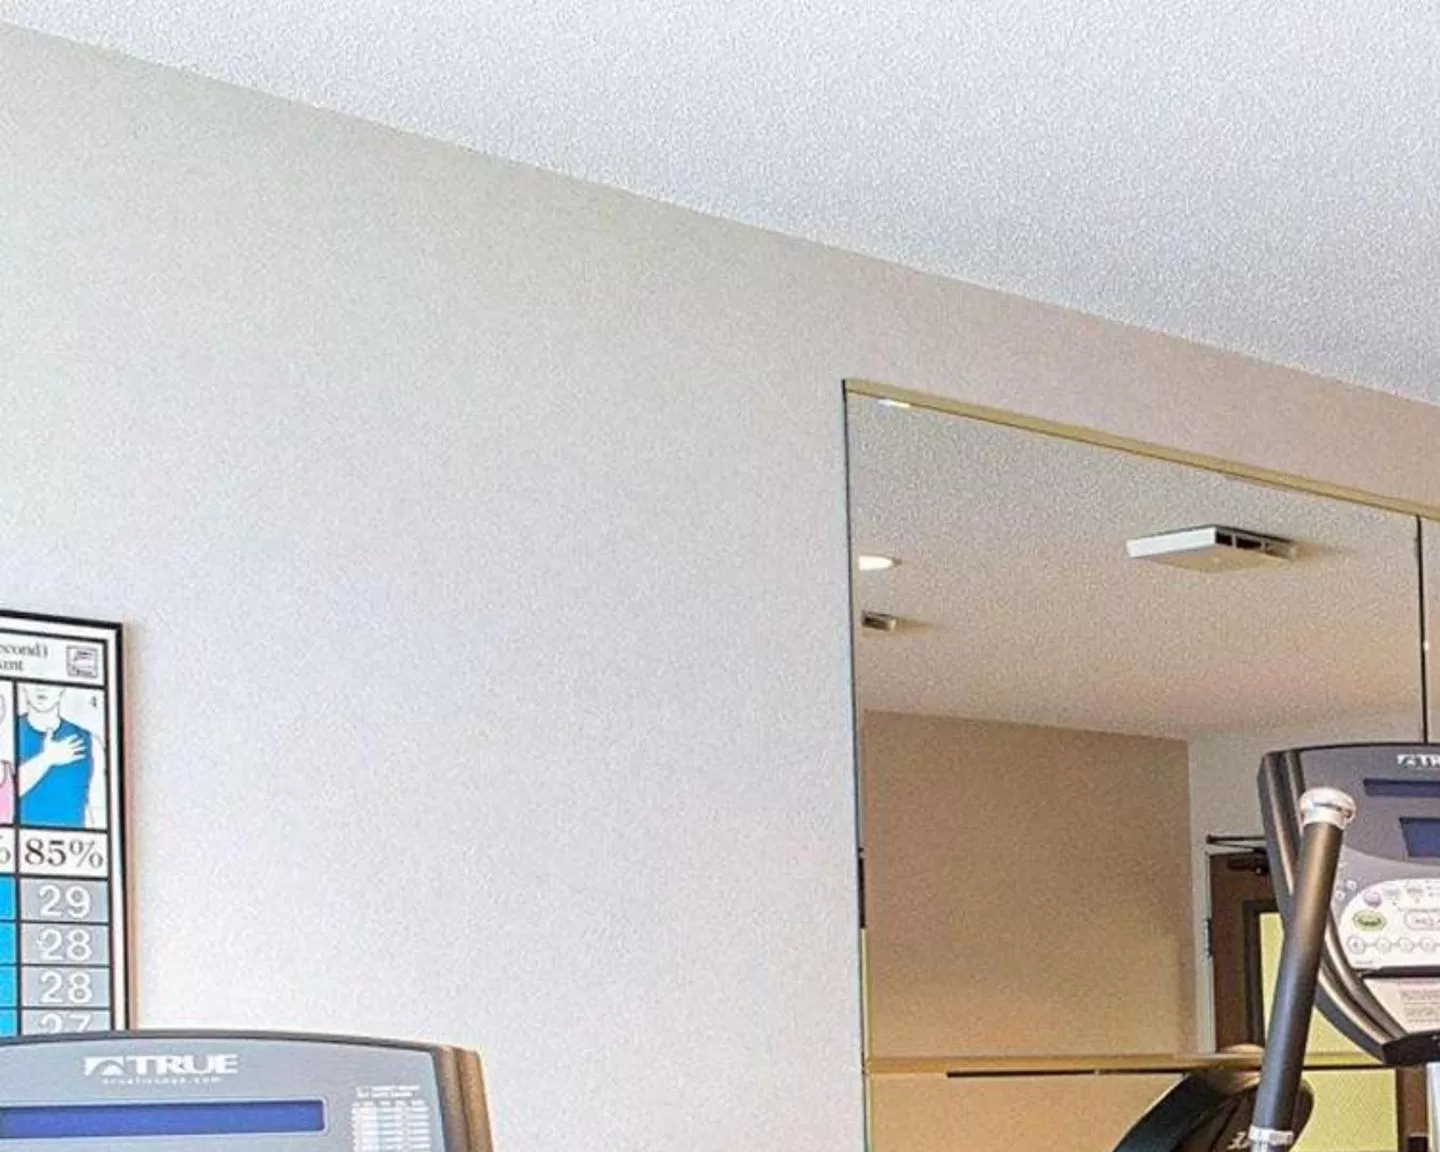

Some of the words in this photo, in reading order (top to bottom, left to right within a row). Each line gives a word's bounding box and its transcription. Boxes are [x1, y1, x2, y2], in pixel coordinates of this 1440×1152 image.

[24, 837, 105, 869] 85%
[40, 884, 91, 919] 29
[39, 929, 93, 961] 28
[41, 971, 93, 1003] 28
[125, 1053, 240, 1076] TRUE
